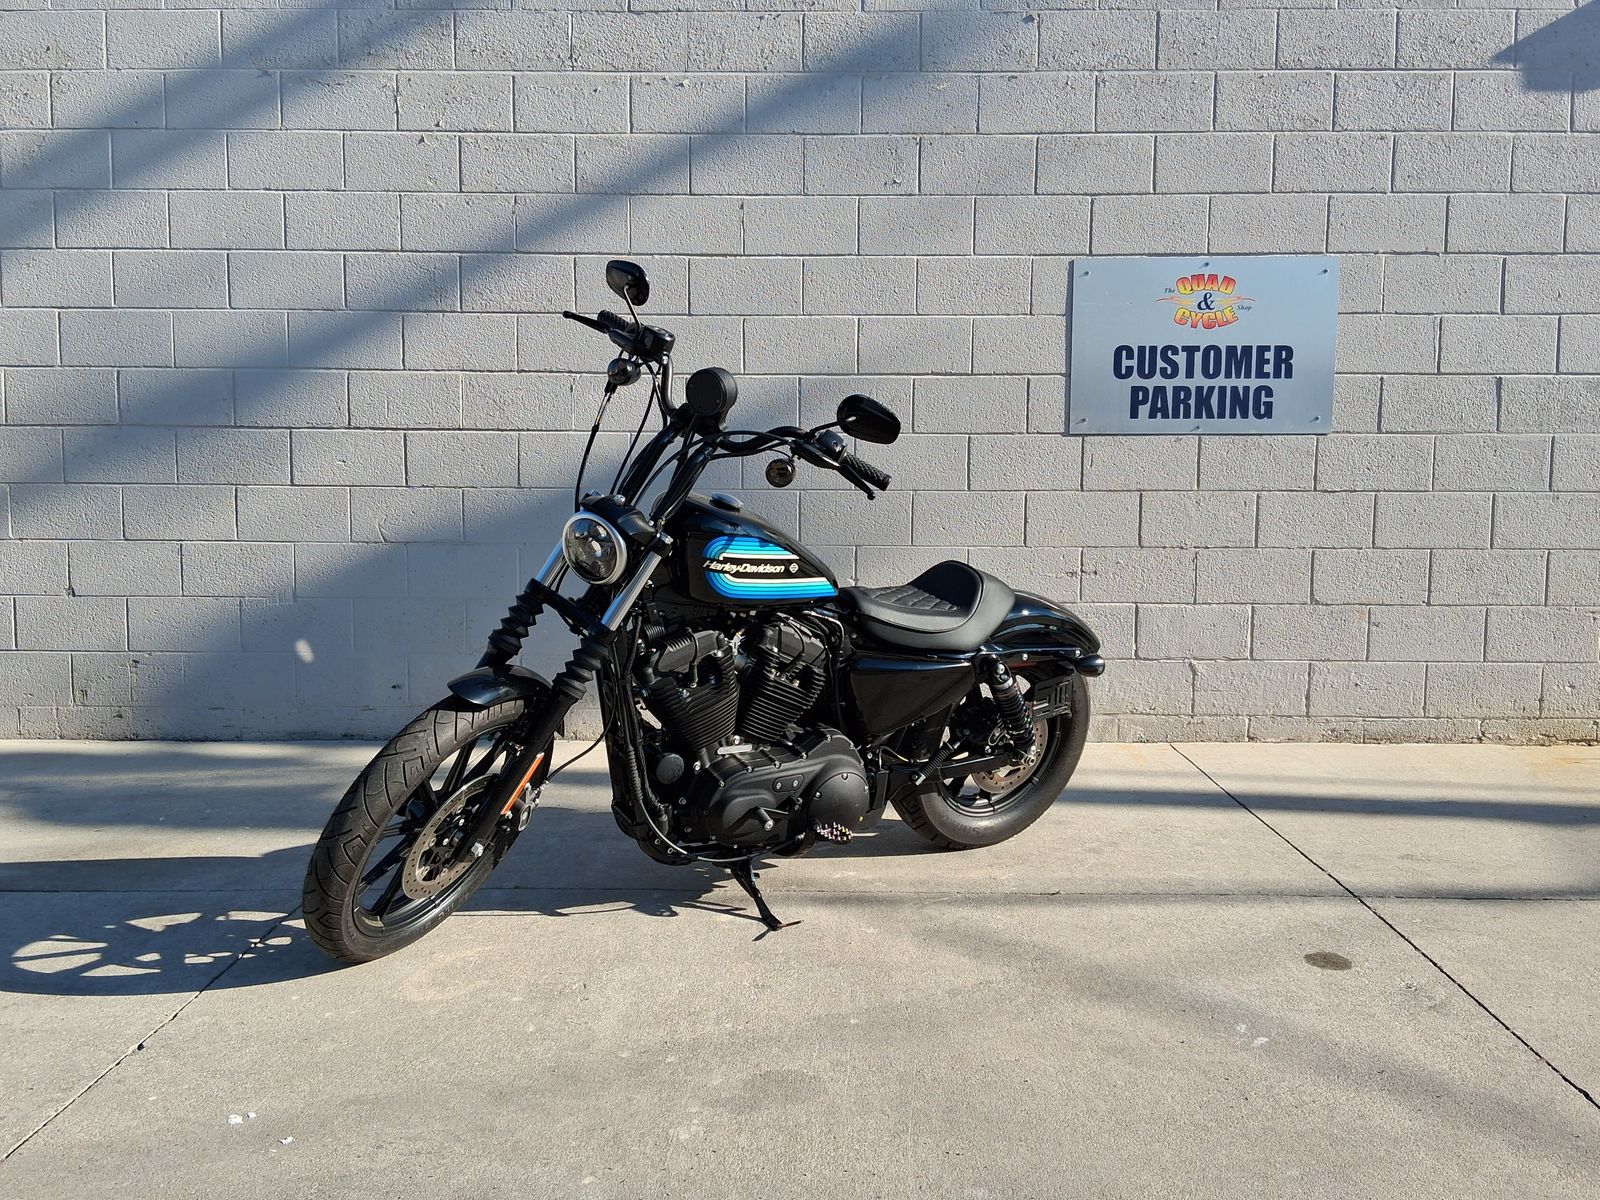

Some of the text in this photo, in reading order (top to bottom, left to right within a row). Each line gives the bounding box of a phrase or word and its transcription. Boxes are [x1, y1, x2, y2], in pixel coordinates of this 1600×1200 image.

[1176, 274, 1237, 295] QUAD
[1197, 292, 1215, 310] &
[1174, 305, 1239, 329] CYCLE
[1113, 345, 1295, 380] CUSTOMER
[1129, 385, 1274, 420] PARKING
[702, 560, 786, 574] Harley-Davidson
